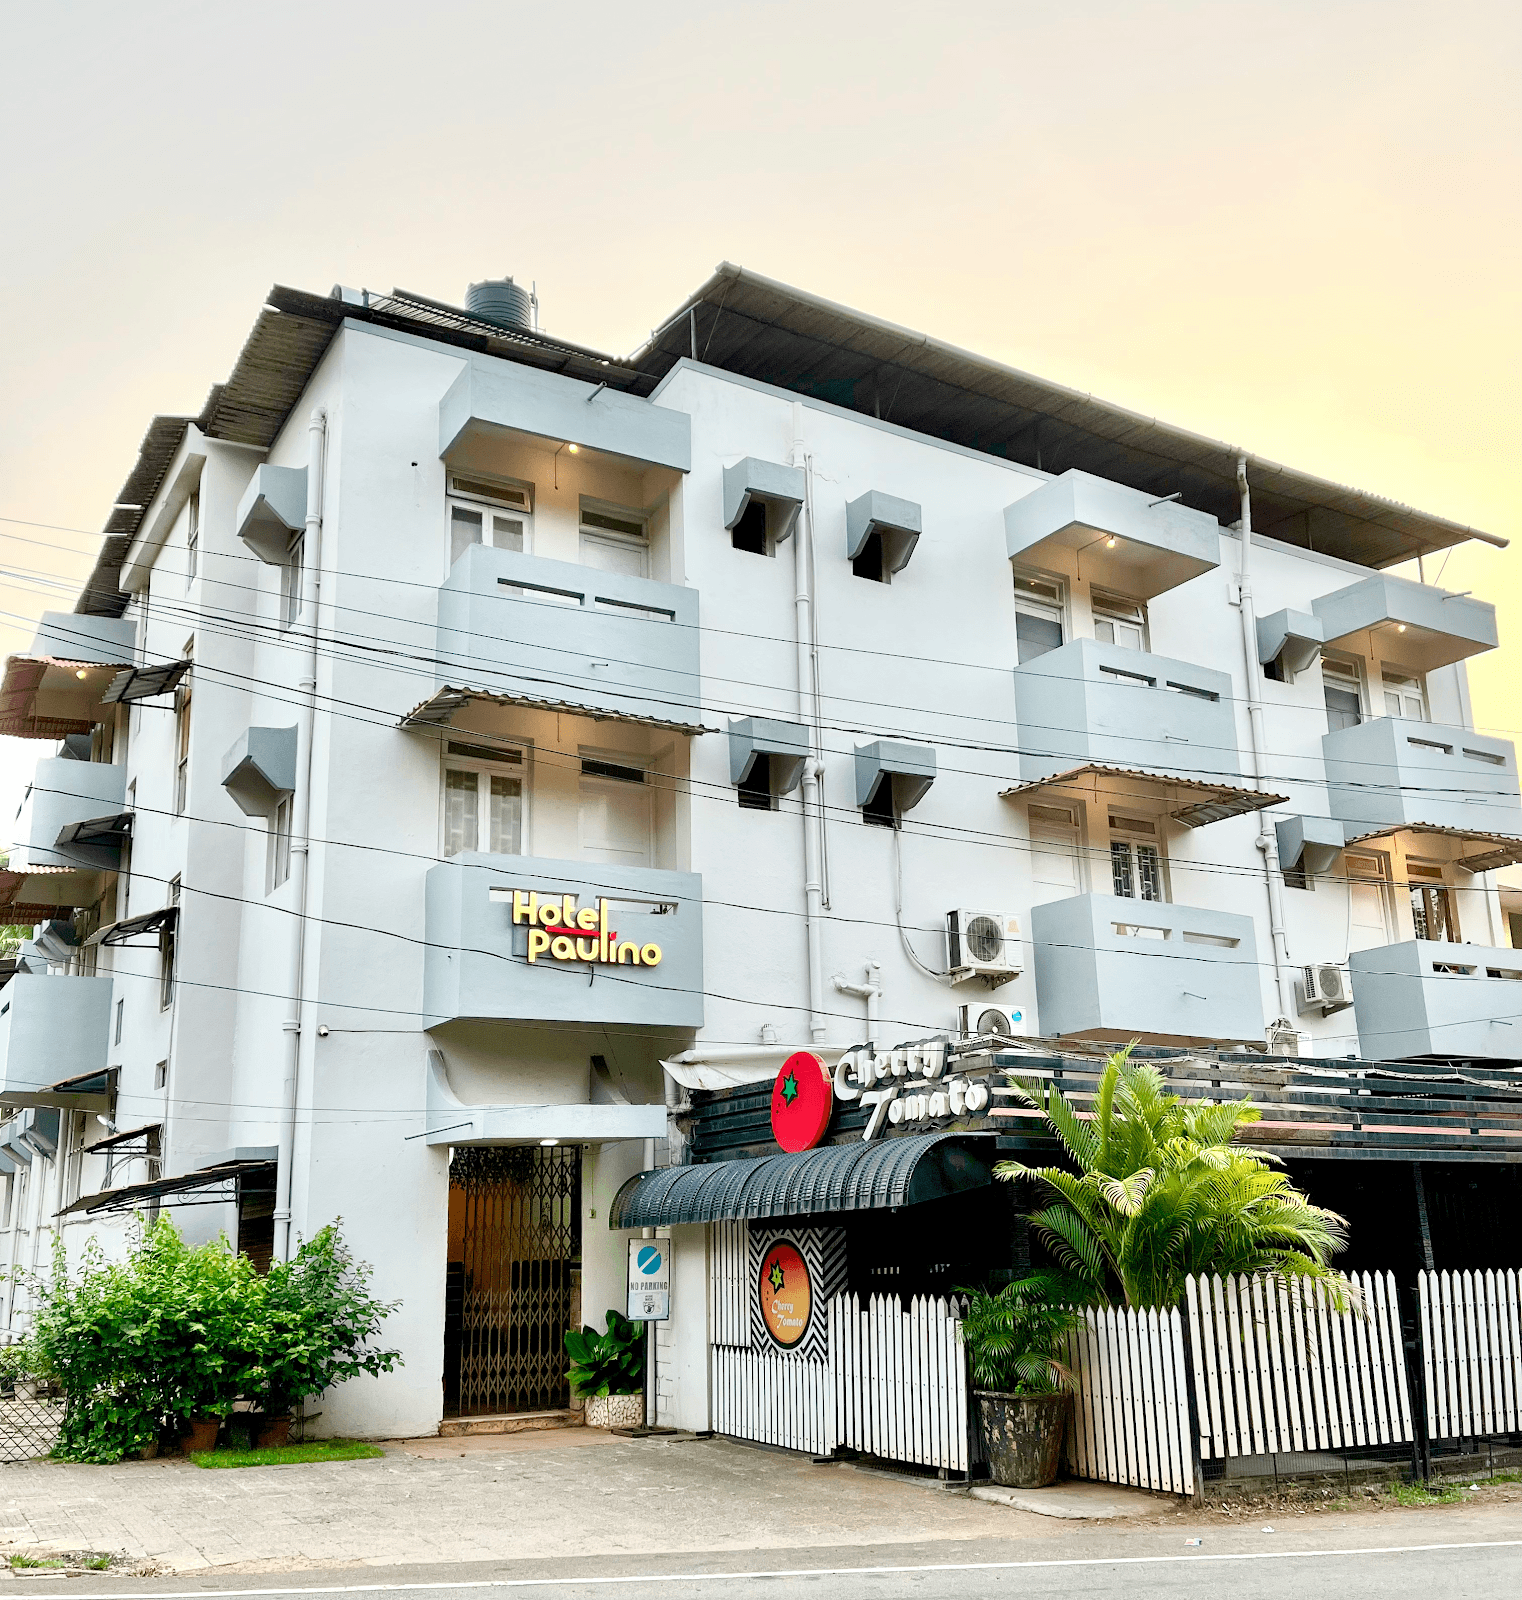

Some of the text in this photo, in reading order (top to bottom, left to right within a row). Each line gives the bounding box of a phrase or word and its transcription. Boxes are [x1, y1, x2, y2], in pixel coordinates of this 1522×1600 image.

[512, 889, 608, 946] Hotel
[527, 915, 663, 966] Paulino
[834, 1040, 948, 1101] Cherry
[859, 1078, 989, 1141] Tomato
[630, 1281, 668, 1291] NO PARKING
[771, 1299, 794, 1314] Cherry
[777, 1314, 804, 1329] Tomato
